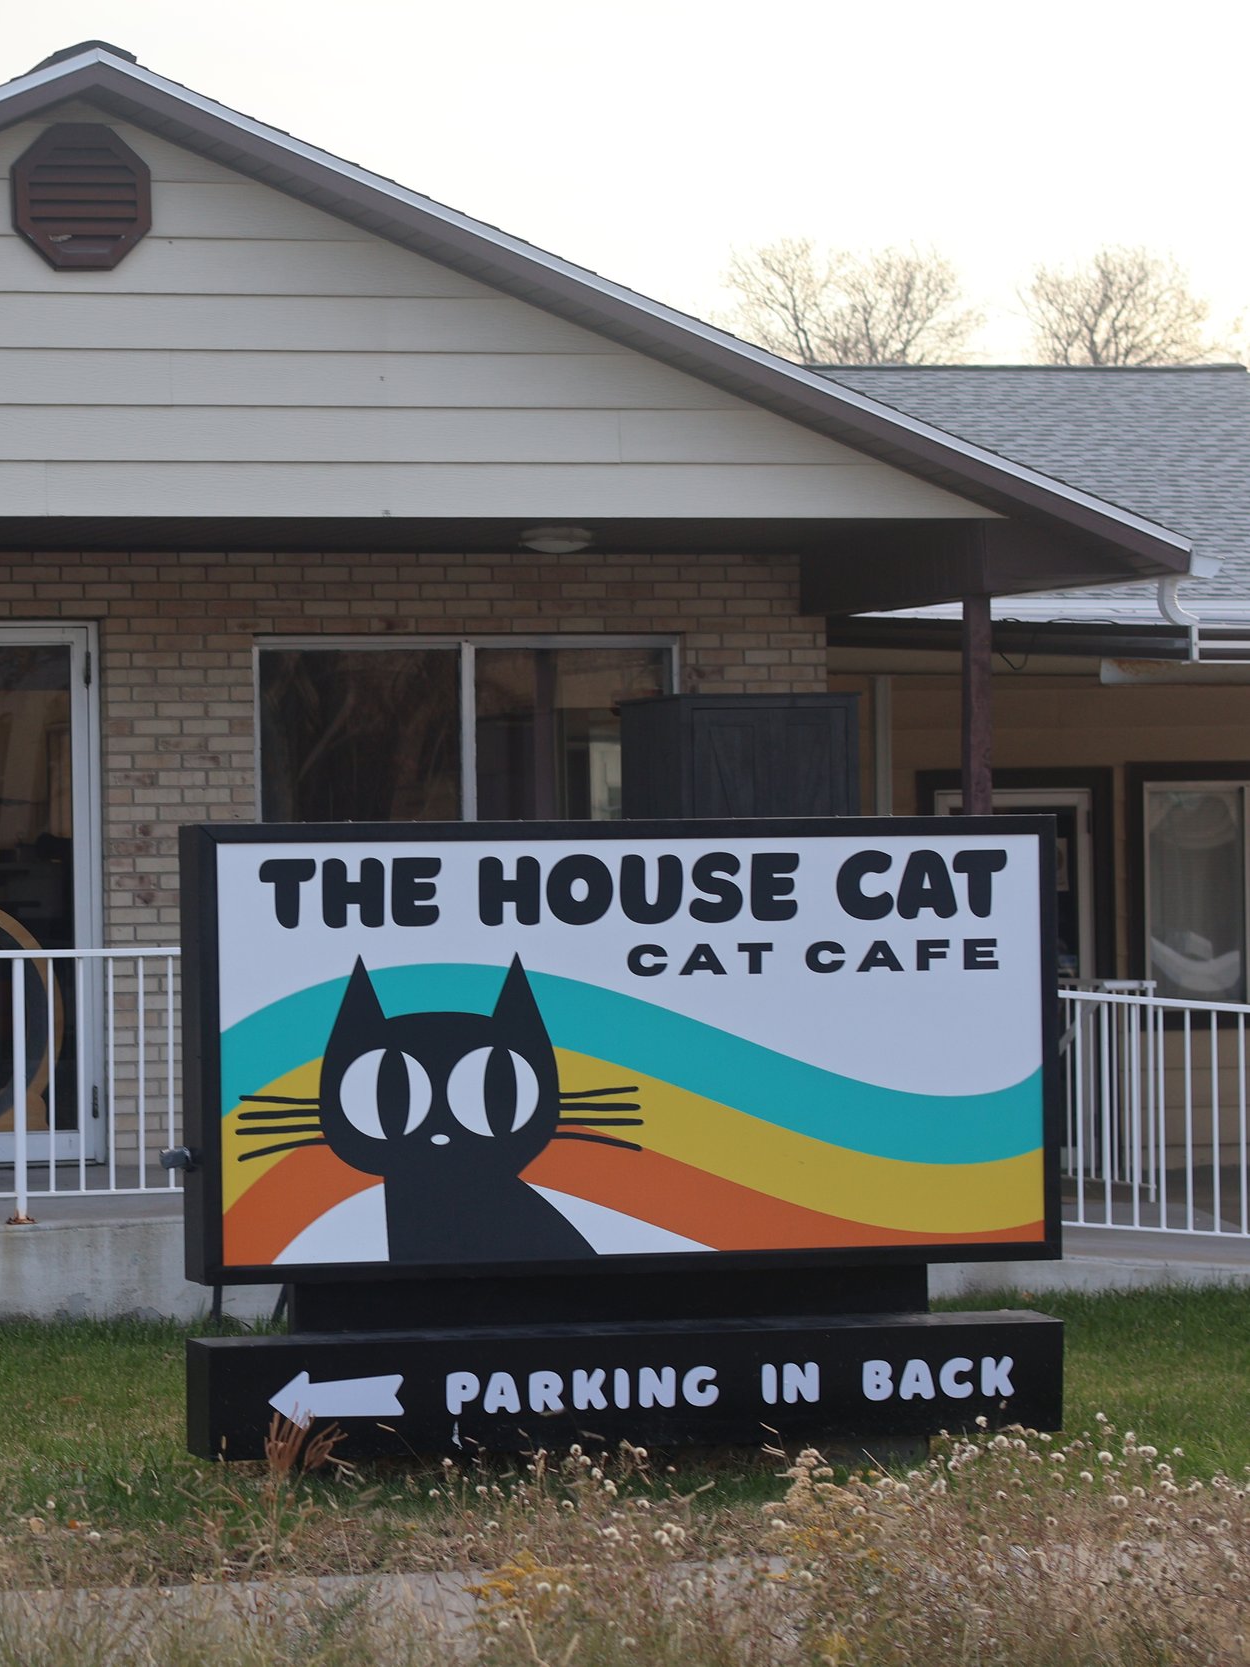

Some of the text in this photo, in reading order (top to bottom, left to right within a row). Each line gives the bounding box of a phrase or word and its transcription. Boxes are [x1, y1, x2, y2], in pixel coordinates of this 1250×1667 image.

[258, 849, 1008, 930] THE HOUSE CAT
[626, 938, 999, 977] CAT CAFE
[445, 1356, 1015, 1415] PARKING IN BACK
